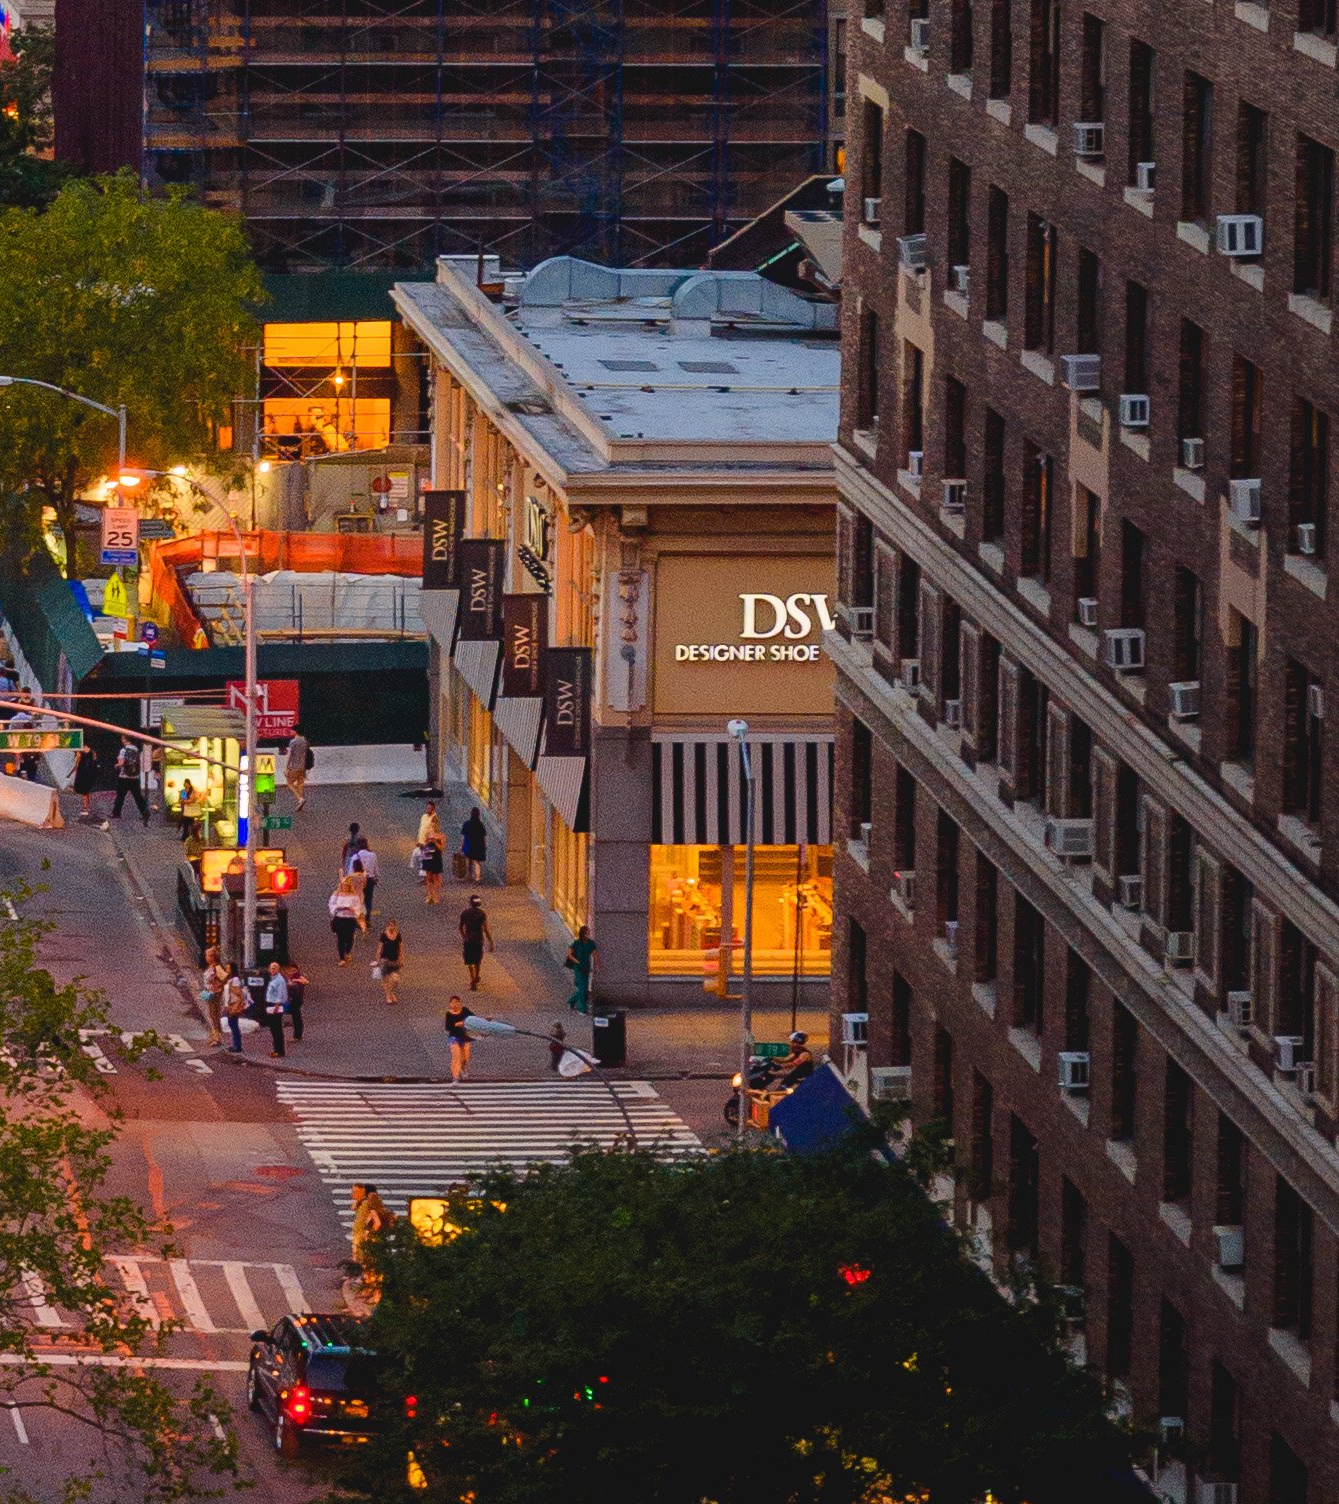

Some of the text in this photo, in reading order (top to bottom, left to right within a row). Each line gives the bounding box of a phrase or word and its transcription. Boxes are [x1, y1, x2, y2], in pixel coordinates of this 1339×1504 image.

[107, 531, 133, 547] 25
[432, 519, 448, 562] DSW
[471, 568, 487, 612] DSW
[514, 625, 531, 670] DSW
[675, 645, 820, 662] DESIGNER SHOE
[557, 679, 574, 726] DSW
[7, 734, 20, 747] W
[26, 734, 41, 747] 79
